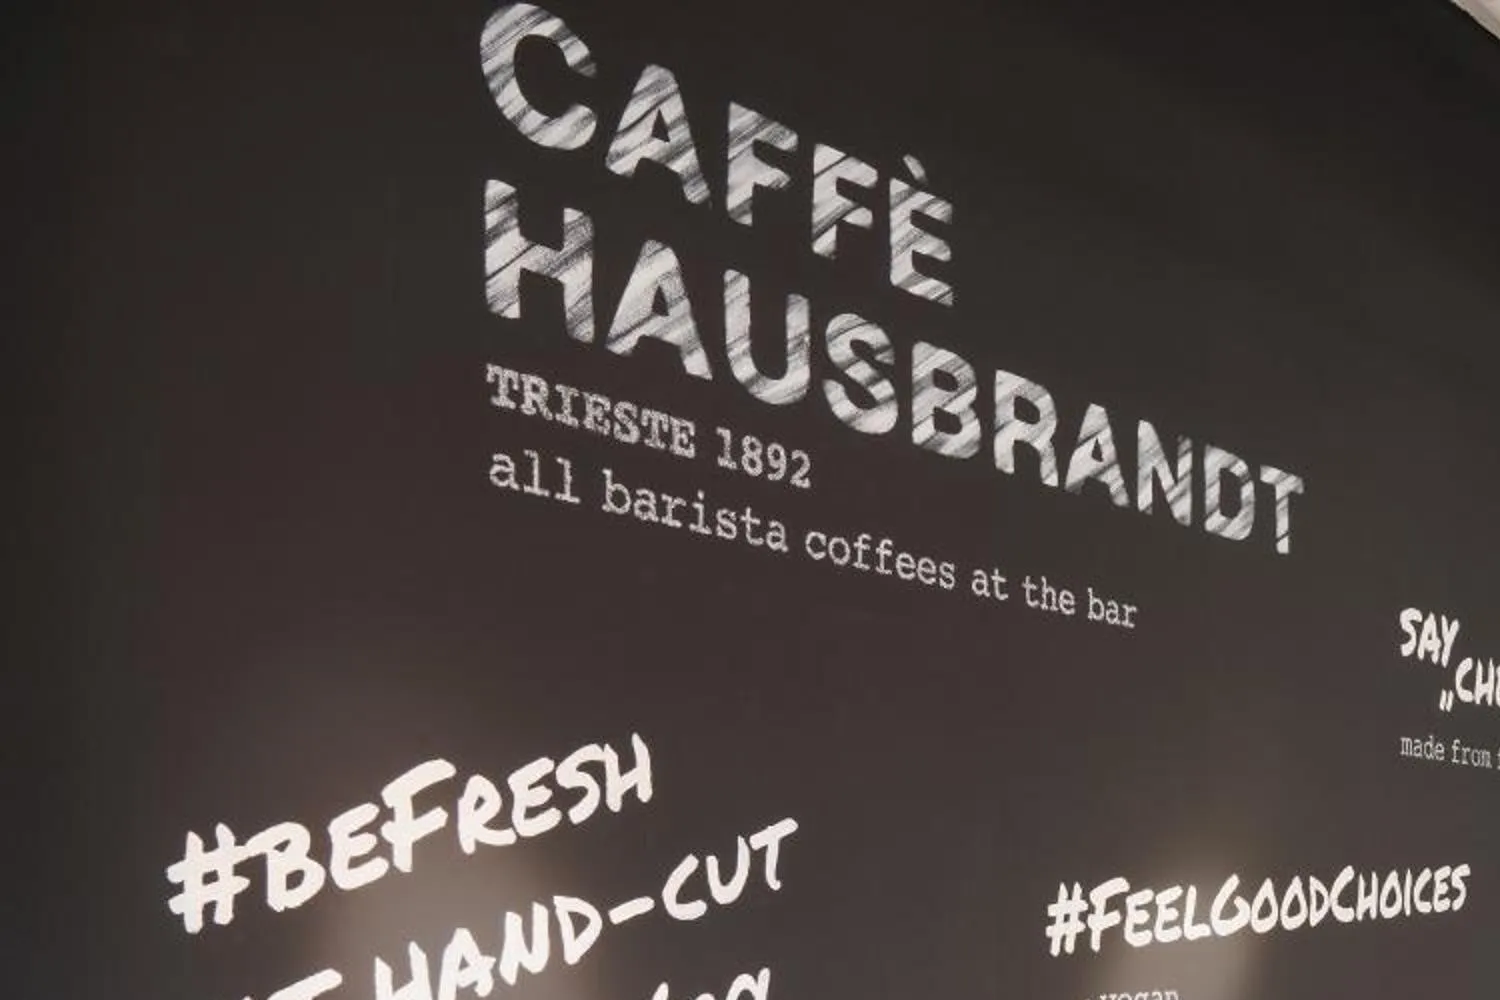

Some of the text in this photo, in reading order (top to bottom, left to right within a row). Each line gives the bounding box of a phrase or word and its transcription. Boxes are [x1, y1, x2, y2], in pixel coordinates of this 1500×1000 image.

[479, 2, 953, 306] CAFFÈ
[484, 179, 1304, 555] HAUSBRANDT
[486, 363, 811, 489] TRIESTE 1892
[489, 449, 1137, 629] all barista coffees at the bar
[1399, 607, 1460, 668] SAY
[167, 732, 655, 934] #BEFRESH
[1400, 734, 1445, 761] made
[1451, 738, 1493, 769] from
